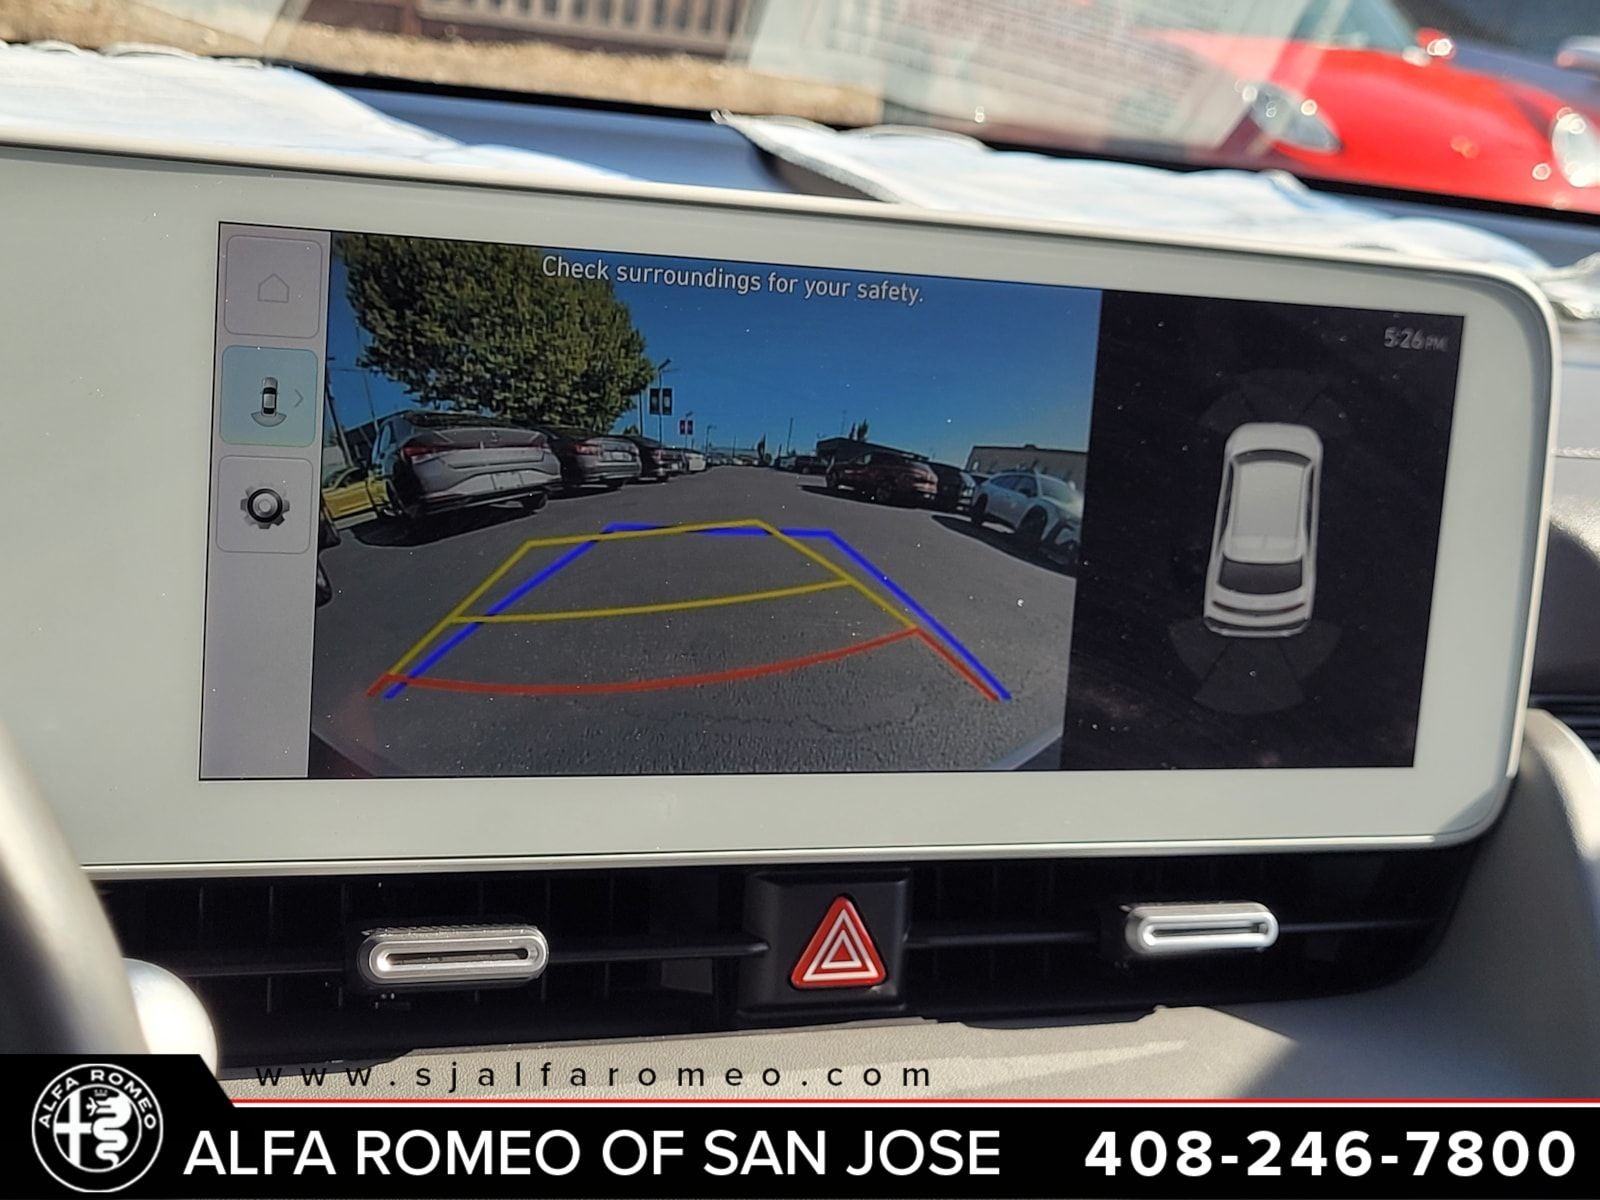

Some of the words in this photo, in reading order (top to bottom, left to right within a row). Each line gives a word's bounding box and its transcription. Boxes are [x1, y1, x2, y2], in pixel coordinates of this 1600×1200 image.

[542, 255, 609, 281] Check
[616, 262, 761, 295] surroundings
[768, 271, 798, 293] for
[803, 277, 851, 299] your
[857, 280, 924, 306] safety.
